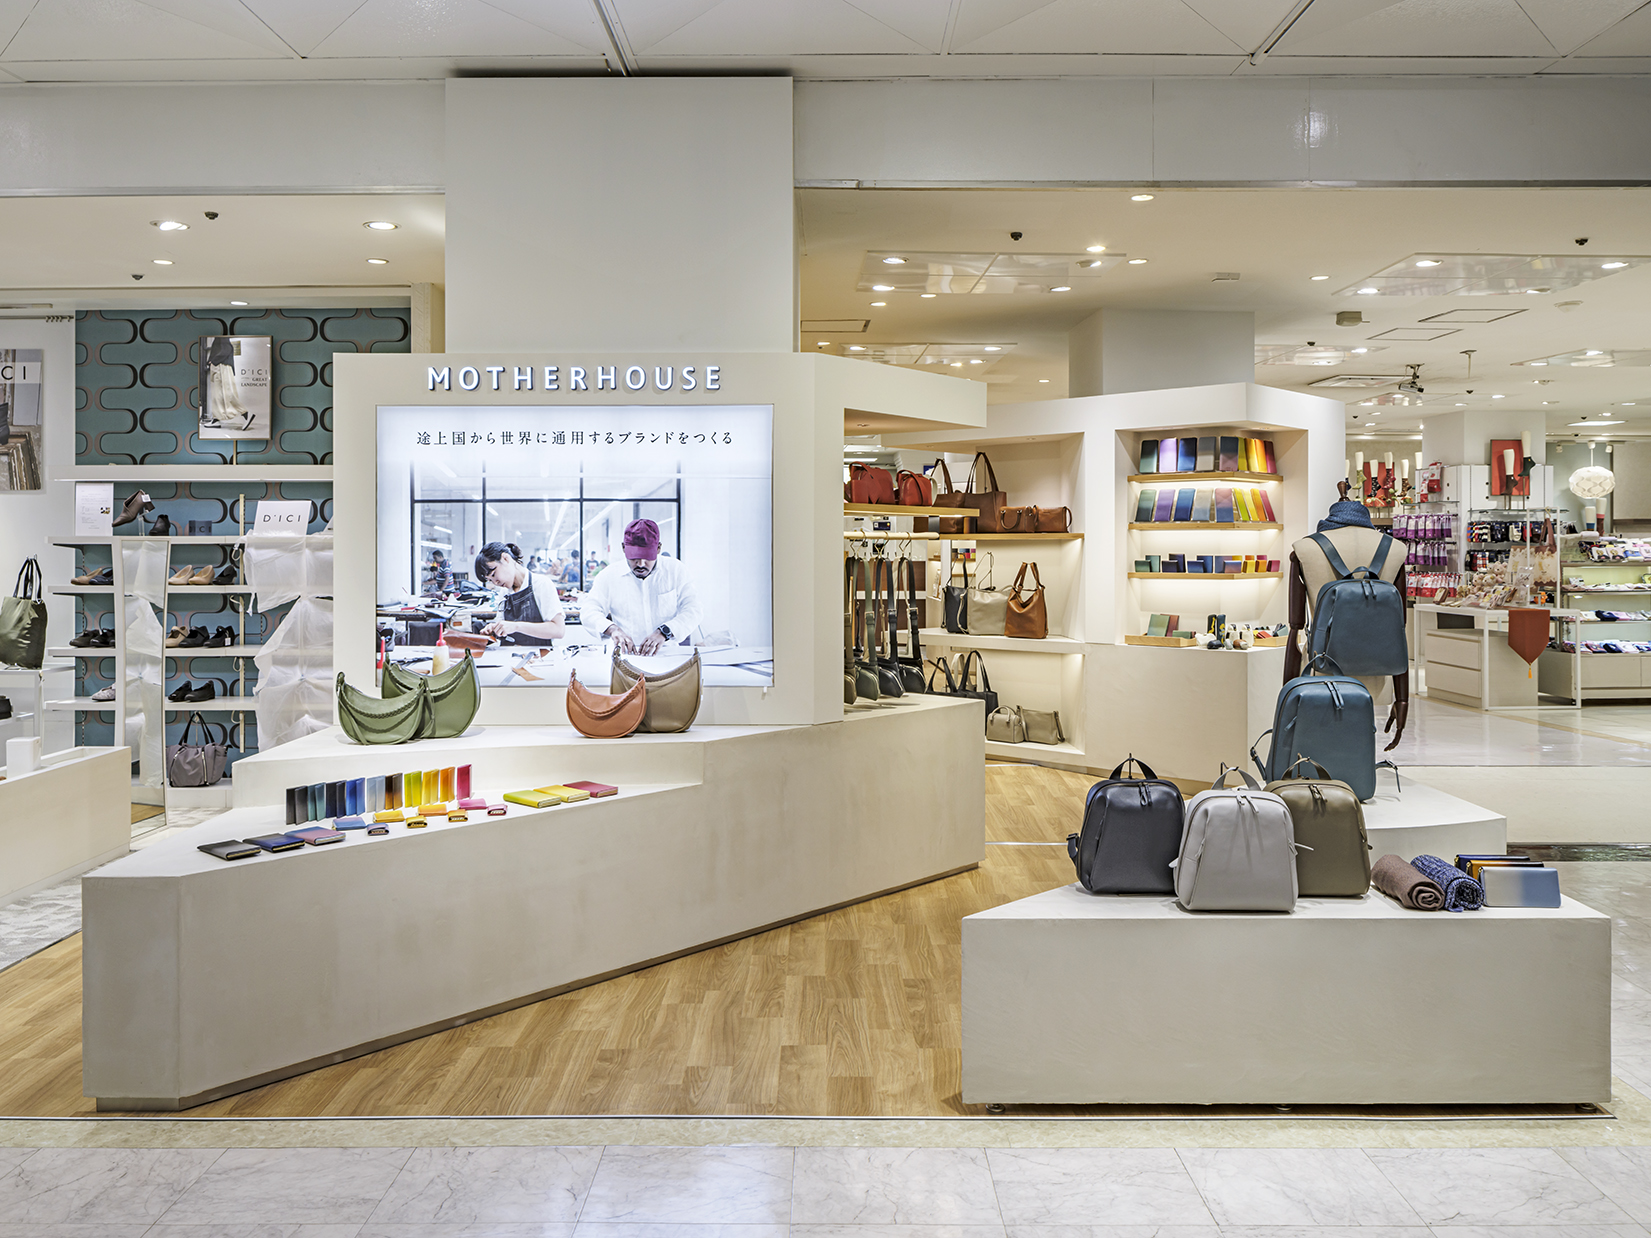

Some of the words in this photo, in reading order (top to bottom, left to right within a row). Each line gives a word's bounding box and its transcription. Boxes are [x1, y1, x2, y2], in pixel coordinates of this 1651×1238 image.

[427, 365, 721, 391] MOTHERHOUSE
[416, 430, 732, 446] 途上国から世界に通用するブランドをつくる
